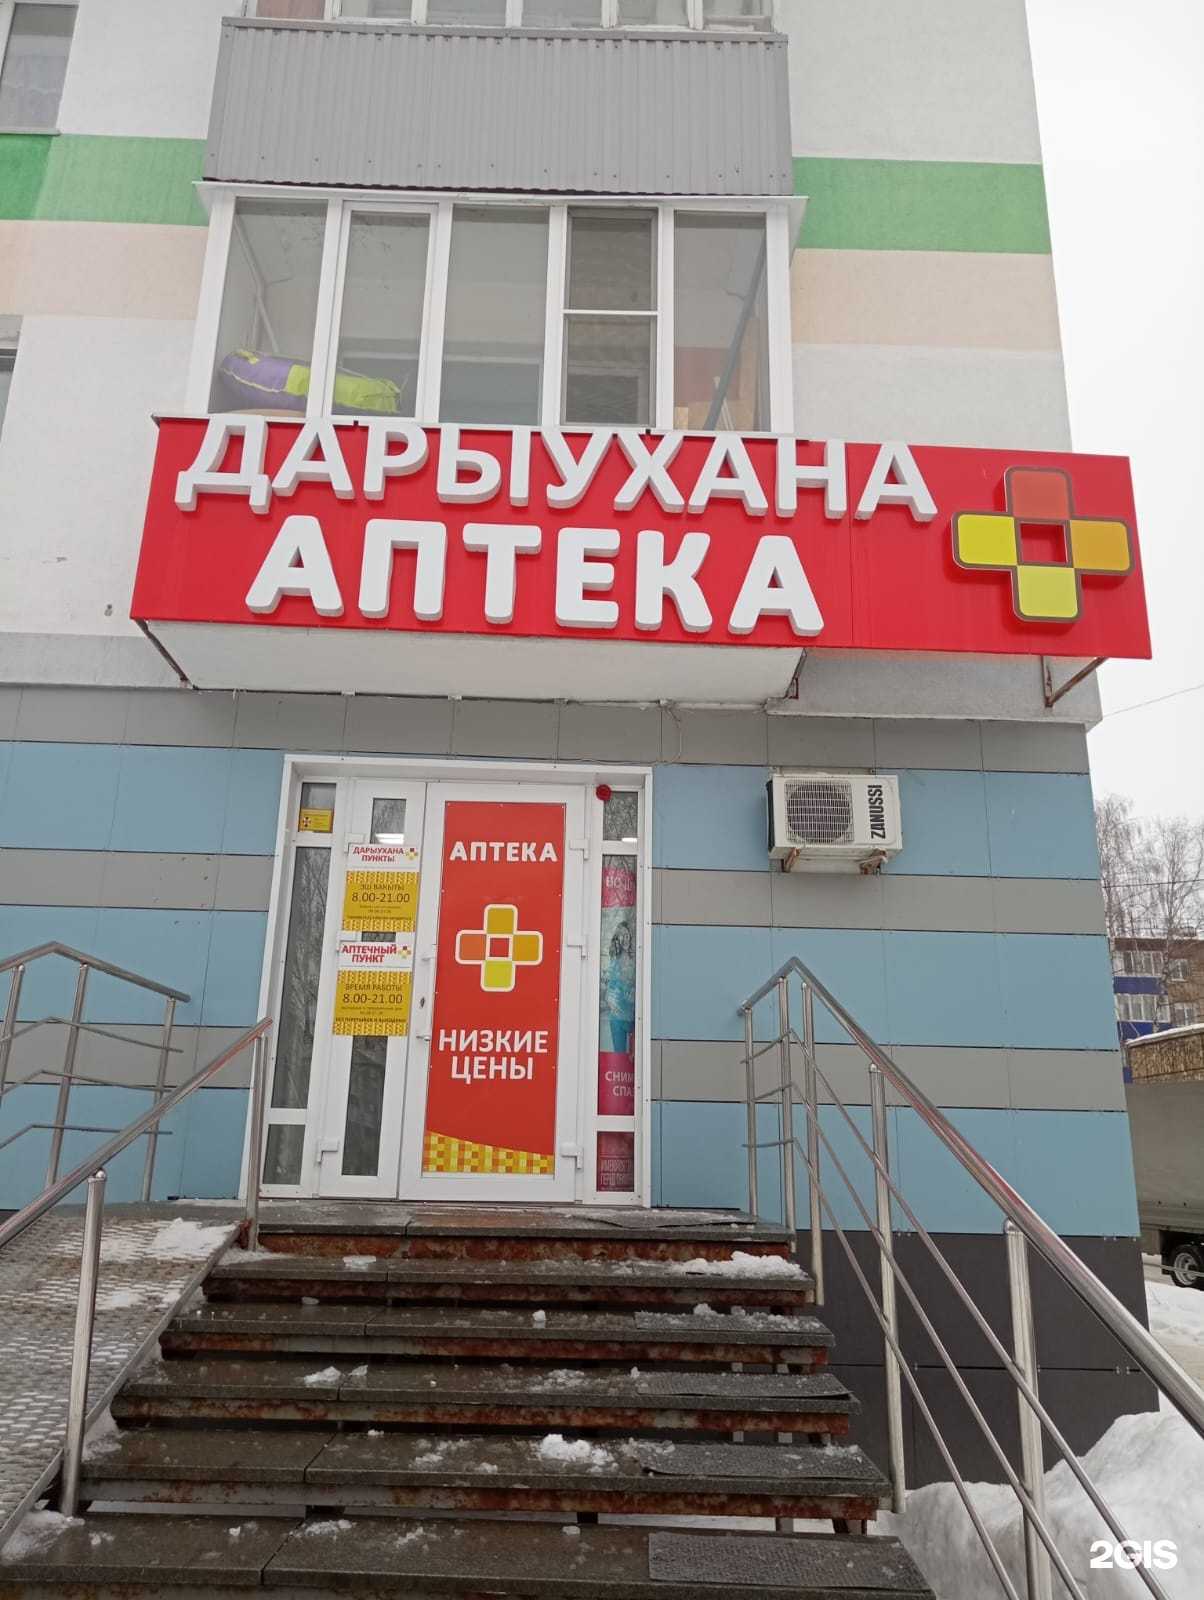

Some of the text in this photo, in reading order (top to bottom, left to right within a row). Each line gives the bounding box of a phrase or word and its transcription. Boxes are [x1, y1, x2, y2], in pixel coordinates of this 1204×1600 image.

[174, 413, 938, 522] ДАРЫУХАНА
[245, 514, 825, 636] АПТЕКА
[867, 784, 886, 839] ZANUSSI
[353, 847, 404, 855] ДАРЫУХАНА
[449, 840, 558, 863] АПТЕКА
[342, 944, 397, 954] АПТЕЧНЫЙ
[352, 954, 385, 963] ПУНКТ
[342, 993, 403, 1004] 8.00-21.00
[438, 1029, 549, 1054] НИЗКИЕ
[450, 1056, 534, 1085] ЦЕНЫ
[612, 1085, 635, 1097] СПА
